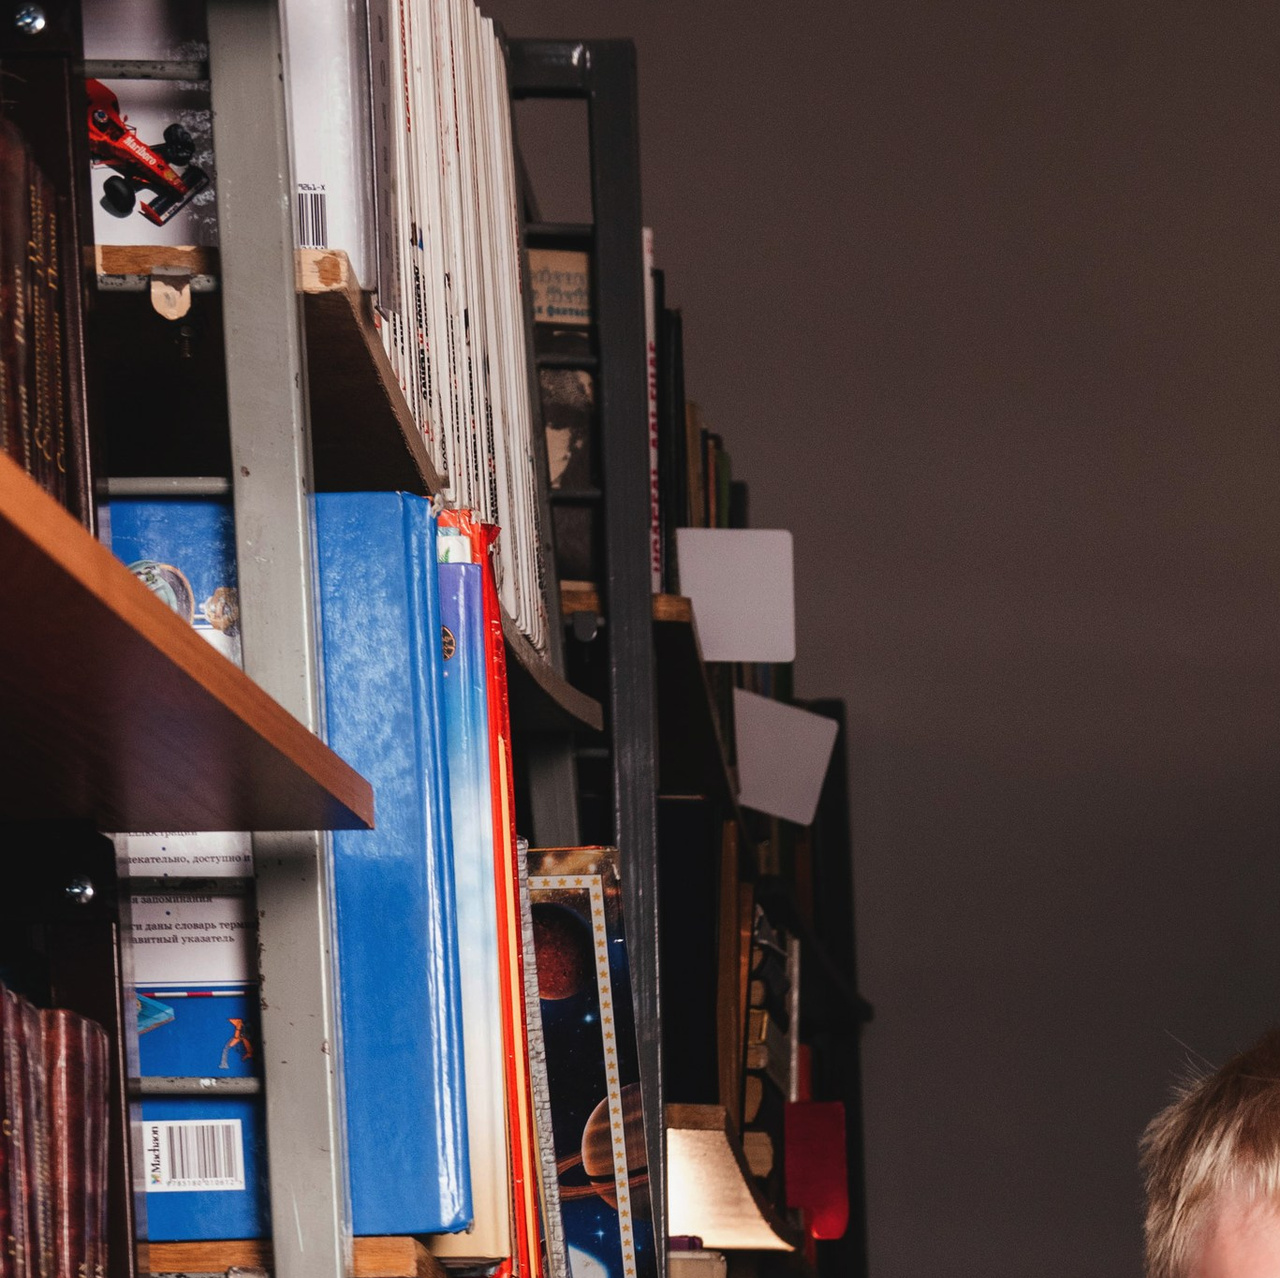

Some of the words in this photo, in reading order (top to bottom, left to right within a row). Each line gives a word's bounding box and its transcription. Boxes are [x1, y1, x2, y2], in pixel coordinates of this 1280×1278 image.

[122, 135, 157, 166] Marlboro
[192, 856, 241, 865] доступно
[145, 922, 173, 932] даны
[175, 921, 216, 931] словарь
[181, 935, 235, 945] указатель
[148, 1126, 162, 1173] Machaon
